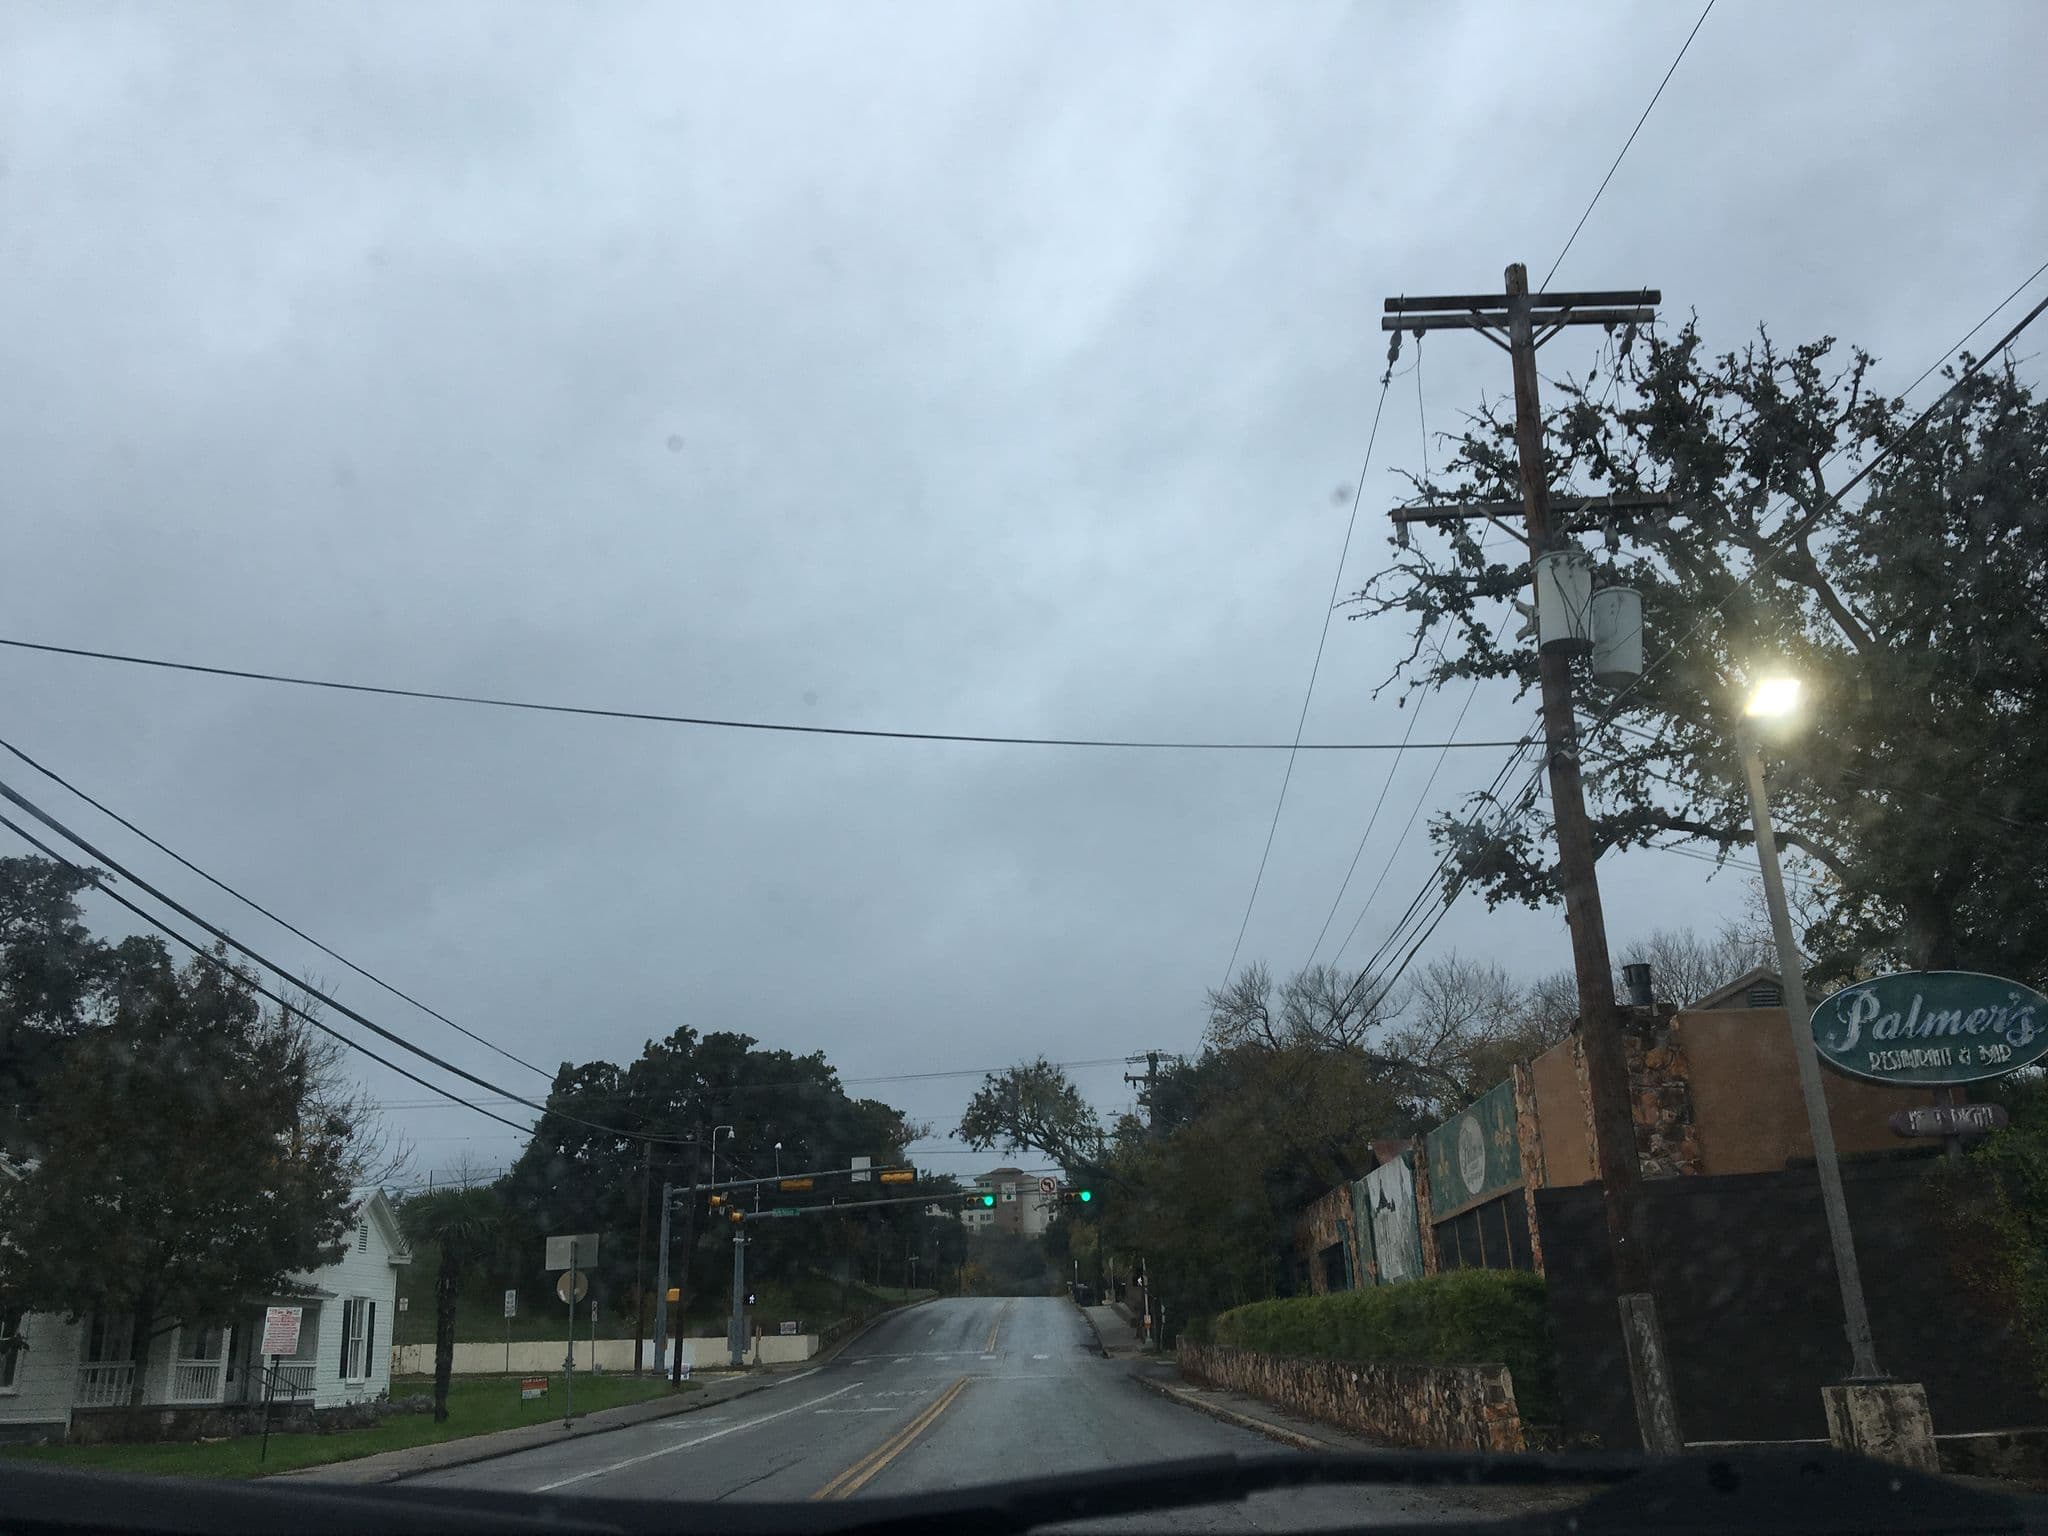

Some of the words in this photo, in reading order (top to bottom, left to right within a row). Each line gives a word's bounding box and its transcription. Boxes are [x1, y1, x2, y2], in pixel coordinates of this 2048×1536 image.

[1827, 986, 2048, 1051] Palmer's
[1958, 1046, 1971, 1066] &
[1977, 1043, 2012, 1066] BAR
